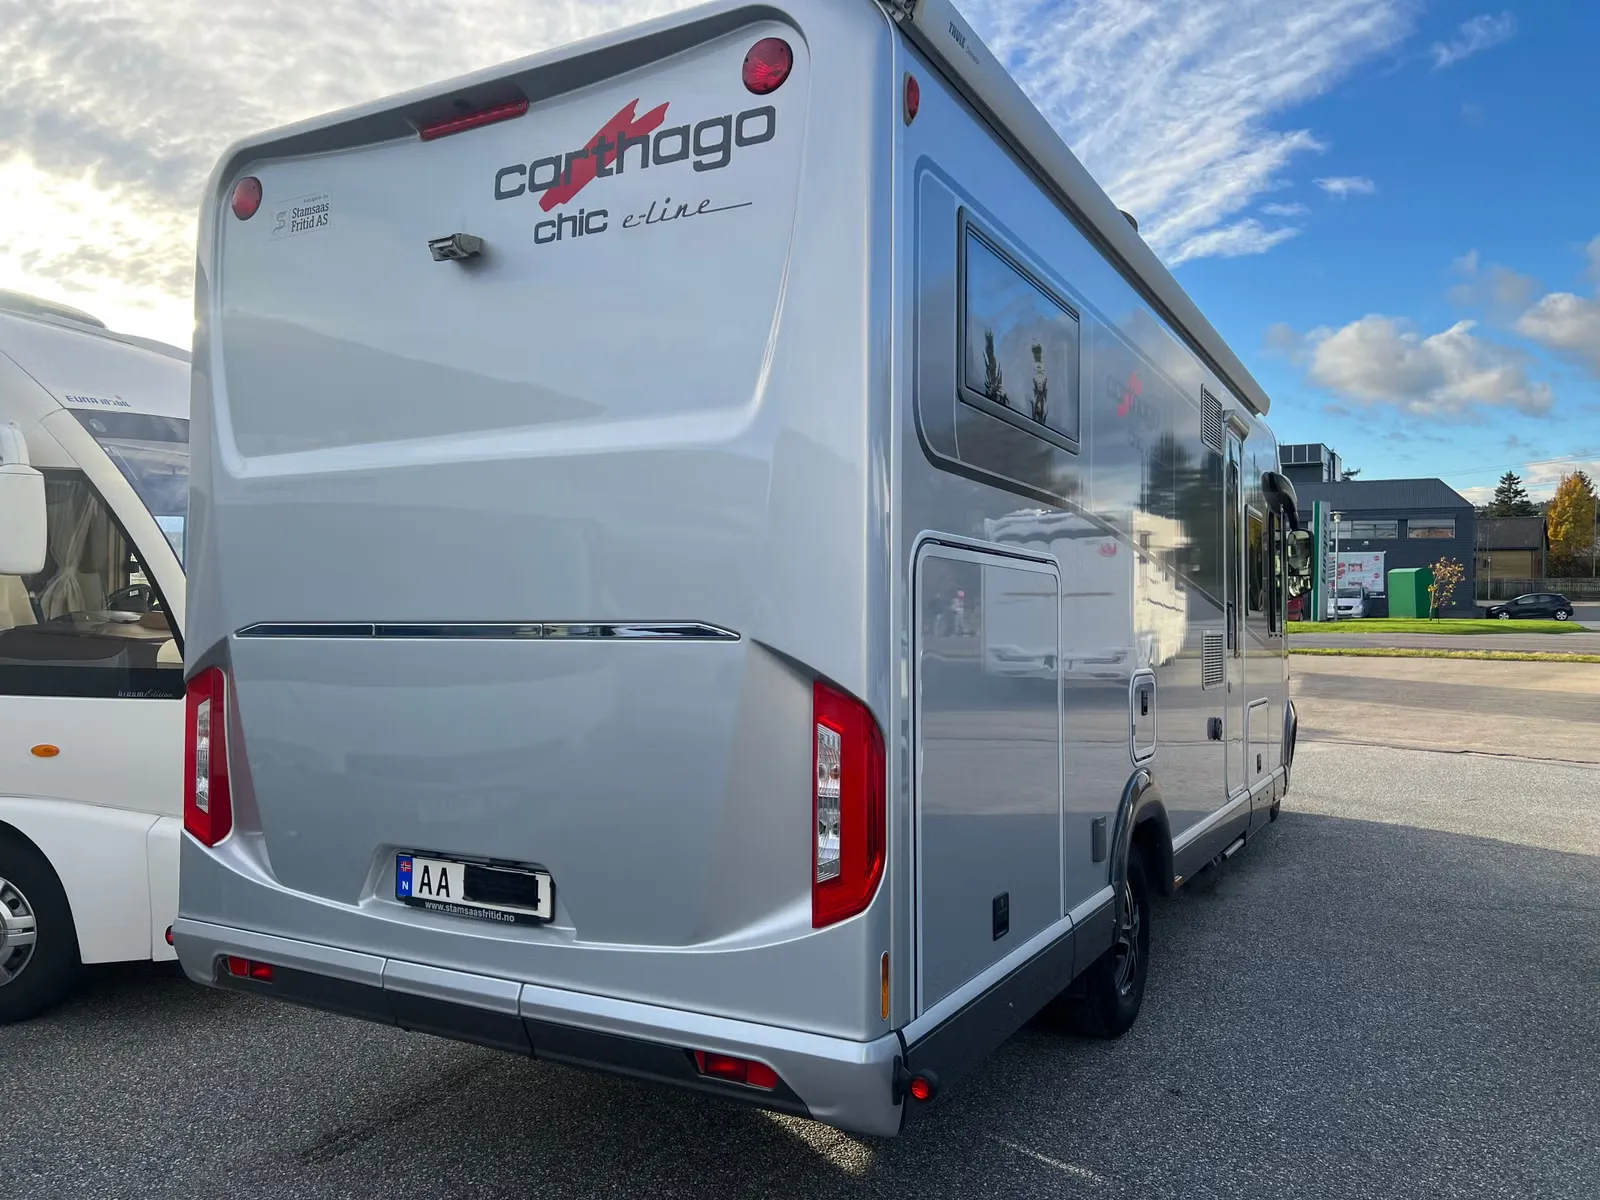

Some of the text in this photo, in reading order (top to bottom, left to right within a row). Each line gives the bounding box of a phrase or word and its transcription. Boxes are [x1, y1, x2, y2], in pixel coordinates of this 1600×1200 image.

[494, 105, 776, 201] carthago
[292, 203, 329, 219] Stamsaas
[533, 197, 753, 245] chic e-line
[291, 213, 329, 232] Fritid AS
[401, 880, 409, 891] N
[418, 865, 451, 898] AA
[425, 902, 515, 922] www.stamsaasfritid.no
